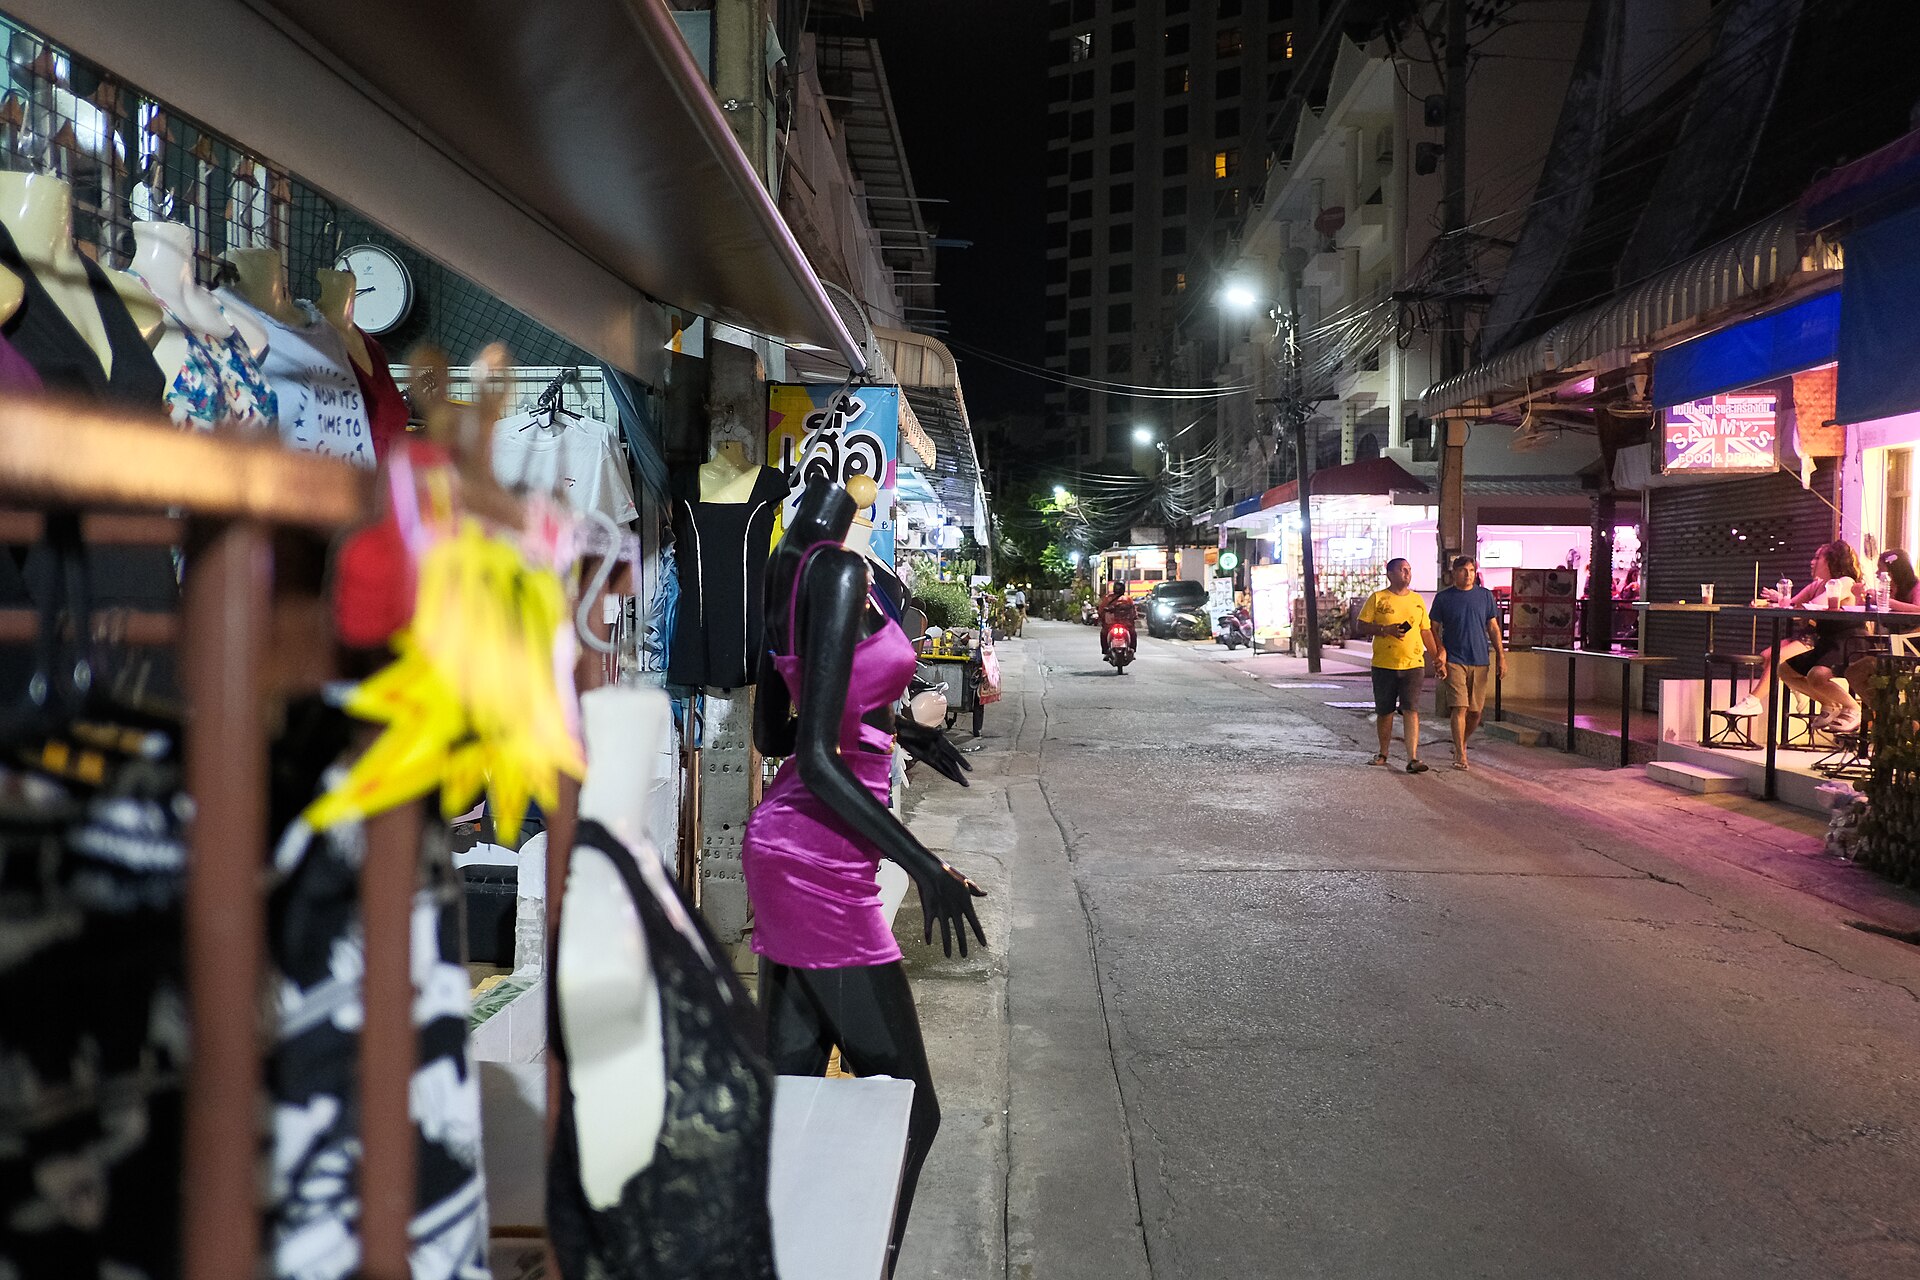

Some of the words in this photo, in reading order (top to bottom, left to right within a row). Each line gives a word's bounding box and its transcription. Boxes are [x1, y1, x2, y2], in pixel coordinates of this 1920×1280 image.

[345, 417, 361, 437] TO
[1672, 418, 1771, 450] SAMMY'S
[1678, 453, 1712, 464] FOOD
[1714, 453, 1723, 463] &
